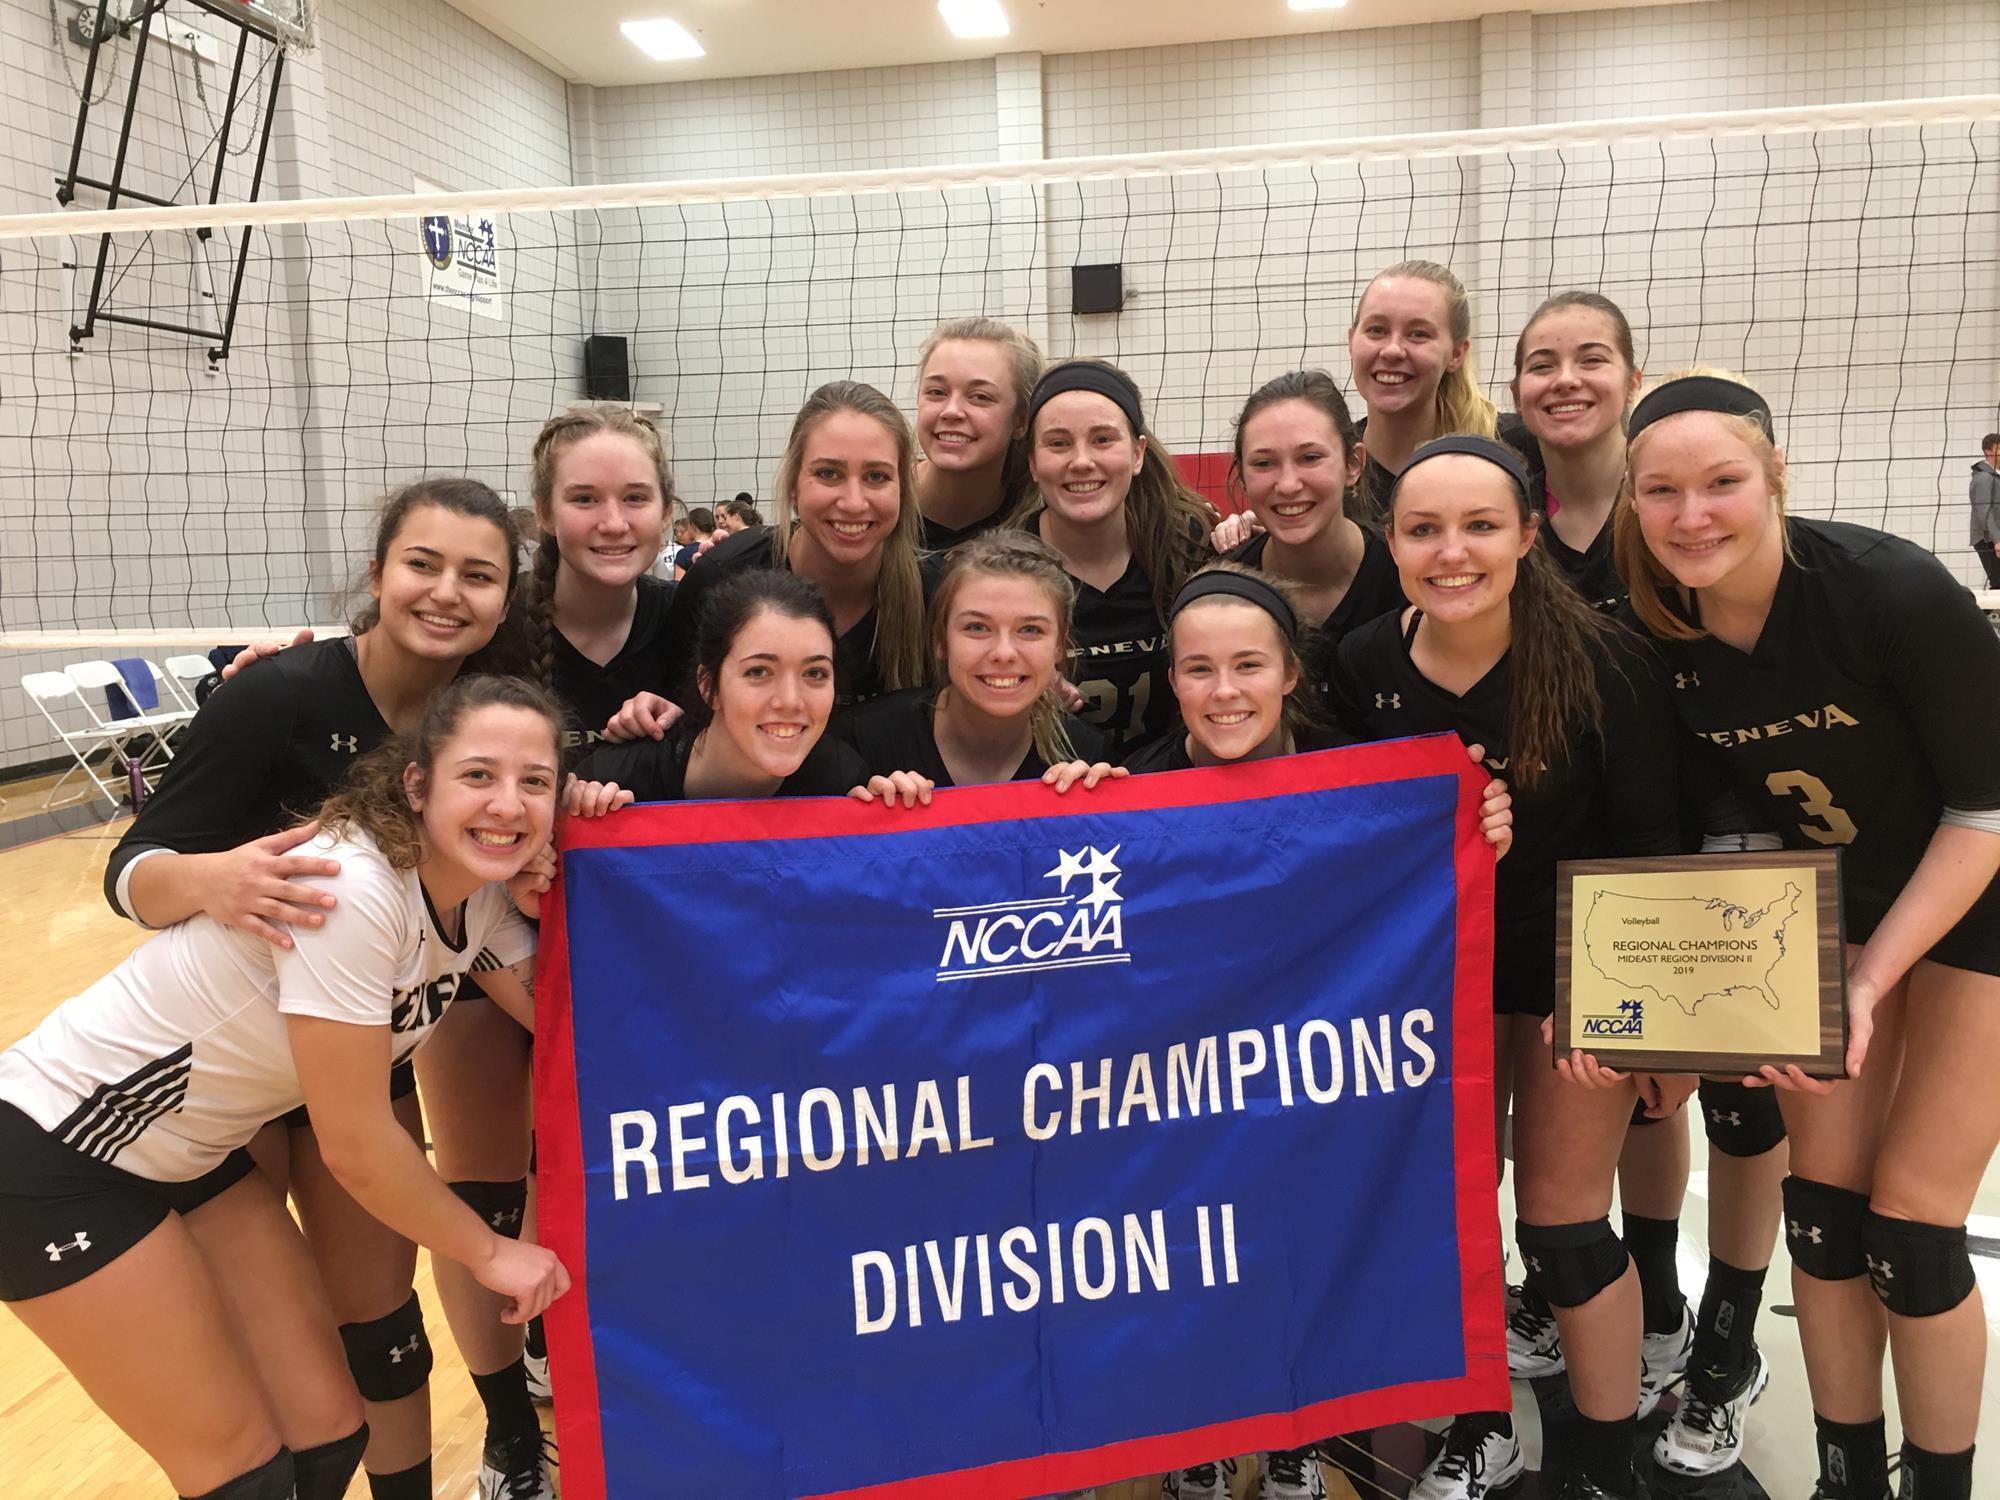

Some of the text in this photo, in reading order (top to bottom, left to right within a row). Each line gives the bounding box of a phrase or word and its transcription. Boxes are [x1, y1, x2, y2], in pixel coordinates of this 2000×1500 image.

[457, 239, 496, 269] NCCAA
[1066, 634, 1168, 658] ENEV
[1696, 704, 1860, 747] ENEVA
[1765, 769, 1859, 845] 3
[1621, 916, 1660, 927] Volleyball
[940, 905, 1123, 967] NCCAA
[1612, 939, 1758, 951] REGIONAL CHAMPIONS
[1617, 954, 1753, 963] MIDEAST REGION DIVISION II
[1673, 966, 1695, 975] 2019
[1583, 1018, 1643, 1034] NCCAA
[610, 1008, 1436, 1201] REGIONAL CHAMPIONS
[851, 1203, 1240, 1335] DIVISION II
